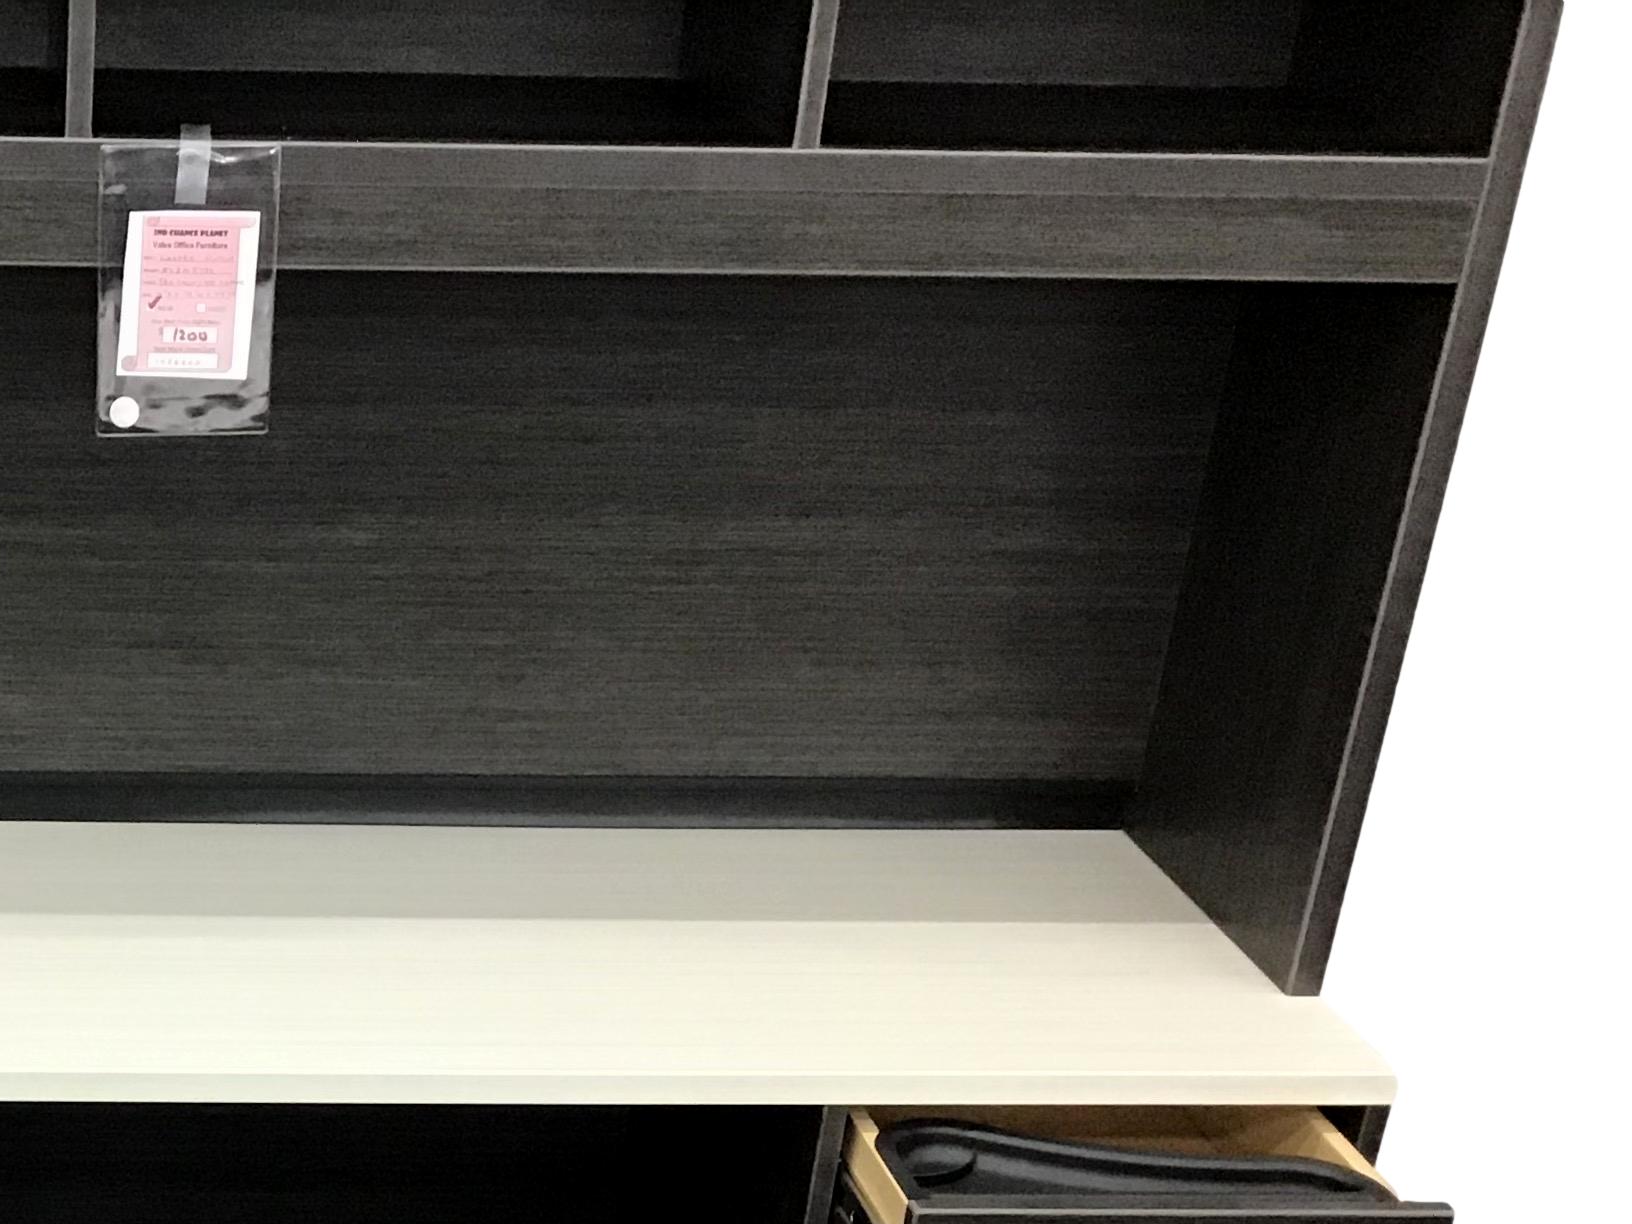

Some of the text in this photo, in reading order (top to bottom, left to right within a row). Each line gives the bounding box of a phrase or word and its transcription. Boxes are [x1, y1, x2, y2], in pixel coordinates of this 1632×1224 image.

[173, 241, 194, 249] Office
[195, 241, 228, 249] Furniture
[173, 327, 208, 342] 1200
